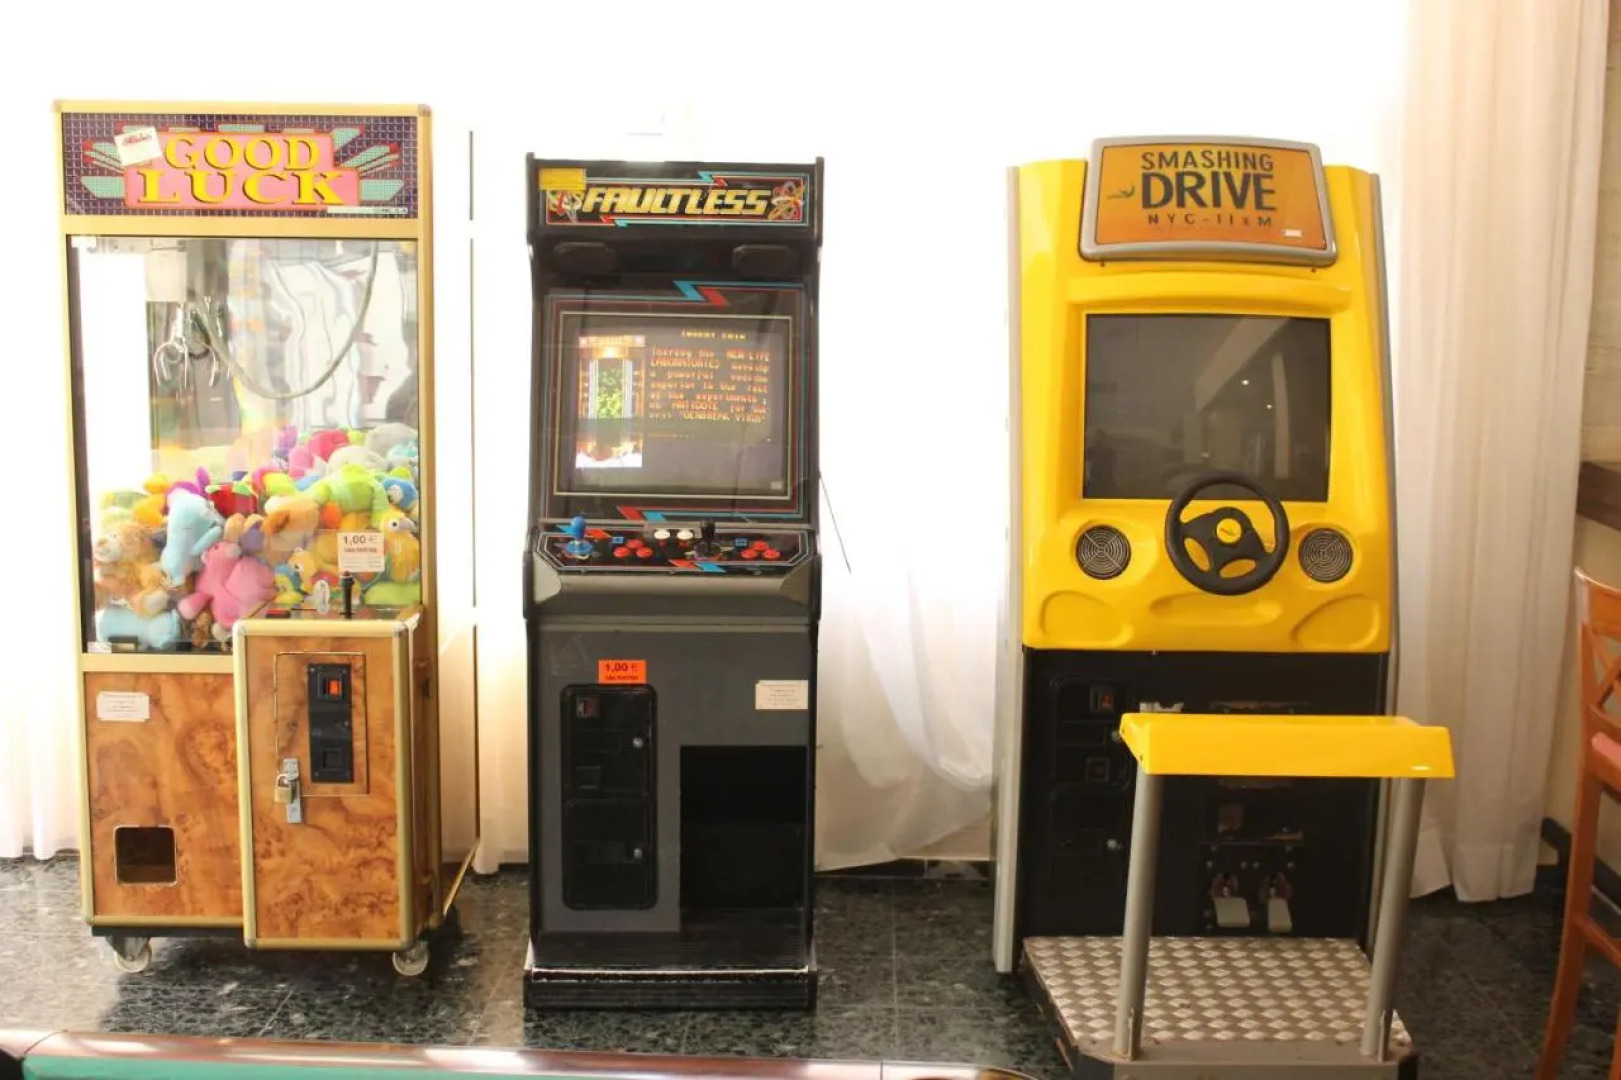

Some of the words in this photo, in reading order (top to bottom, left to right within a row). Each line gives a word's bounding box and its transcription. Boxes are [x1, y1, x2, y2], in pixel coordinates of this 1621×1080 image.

[164, 136, 320, 172] GOOD
[1141, 149, 1274, 172] SMASHING
[136, 168, 345, 205] LUCK
[582, 186, 771, 215] FAULTLESS
[1141, 171, 1277, 211] DRIVE
[343, 535, 367, 546] 1,00
[605, 662, 629, 673] 1,00
